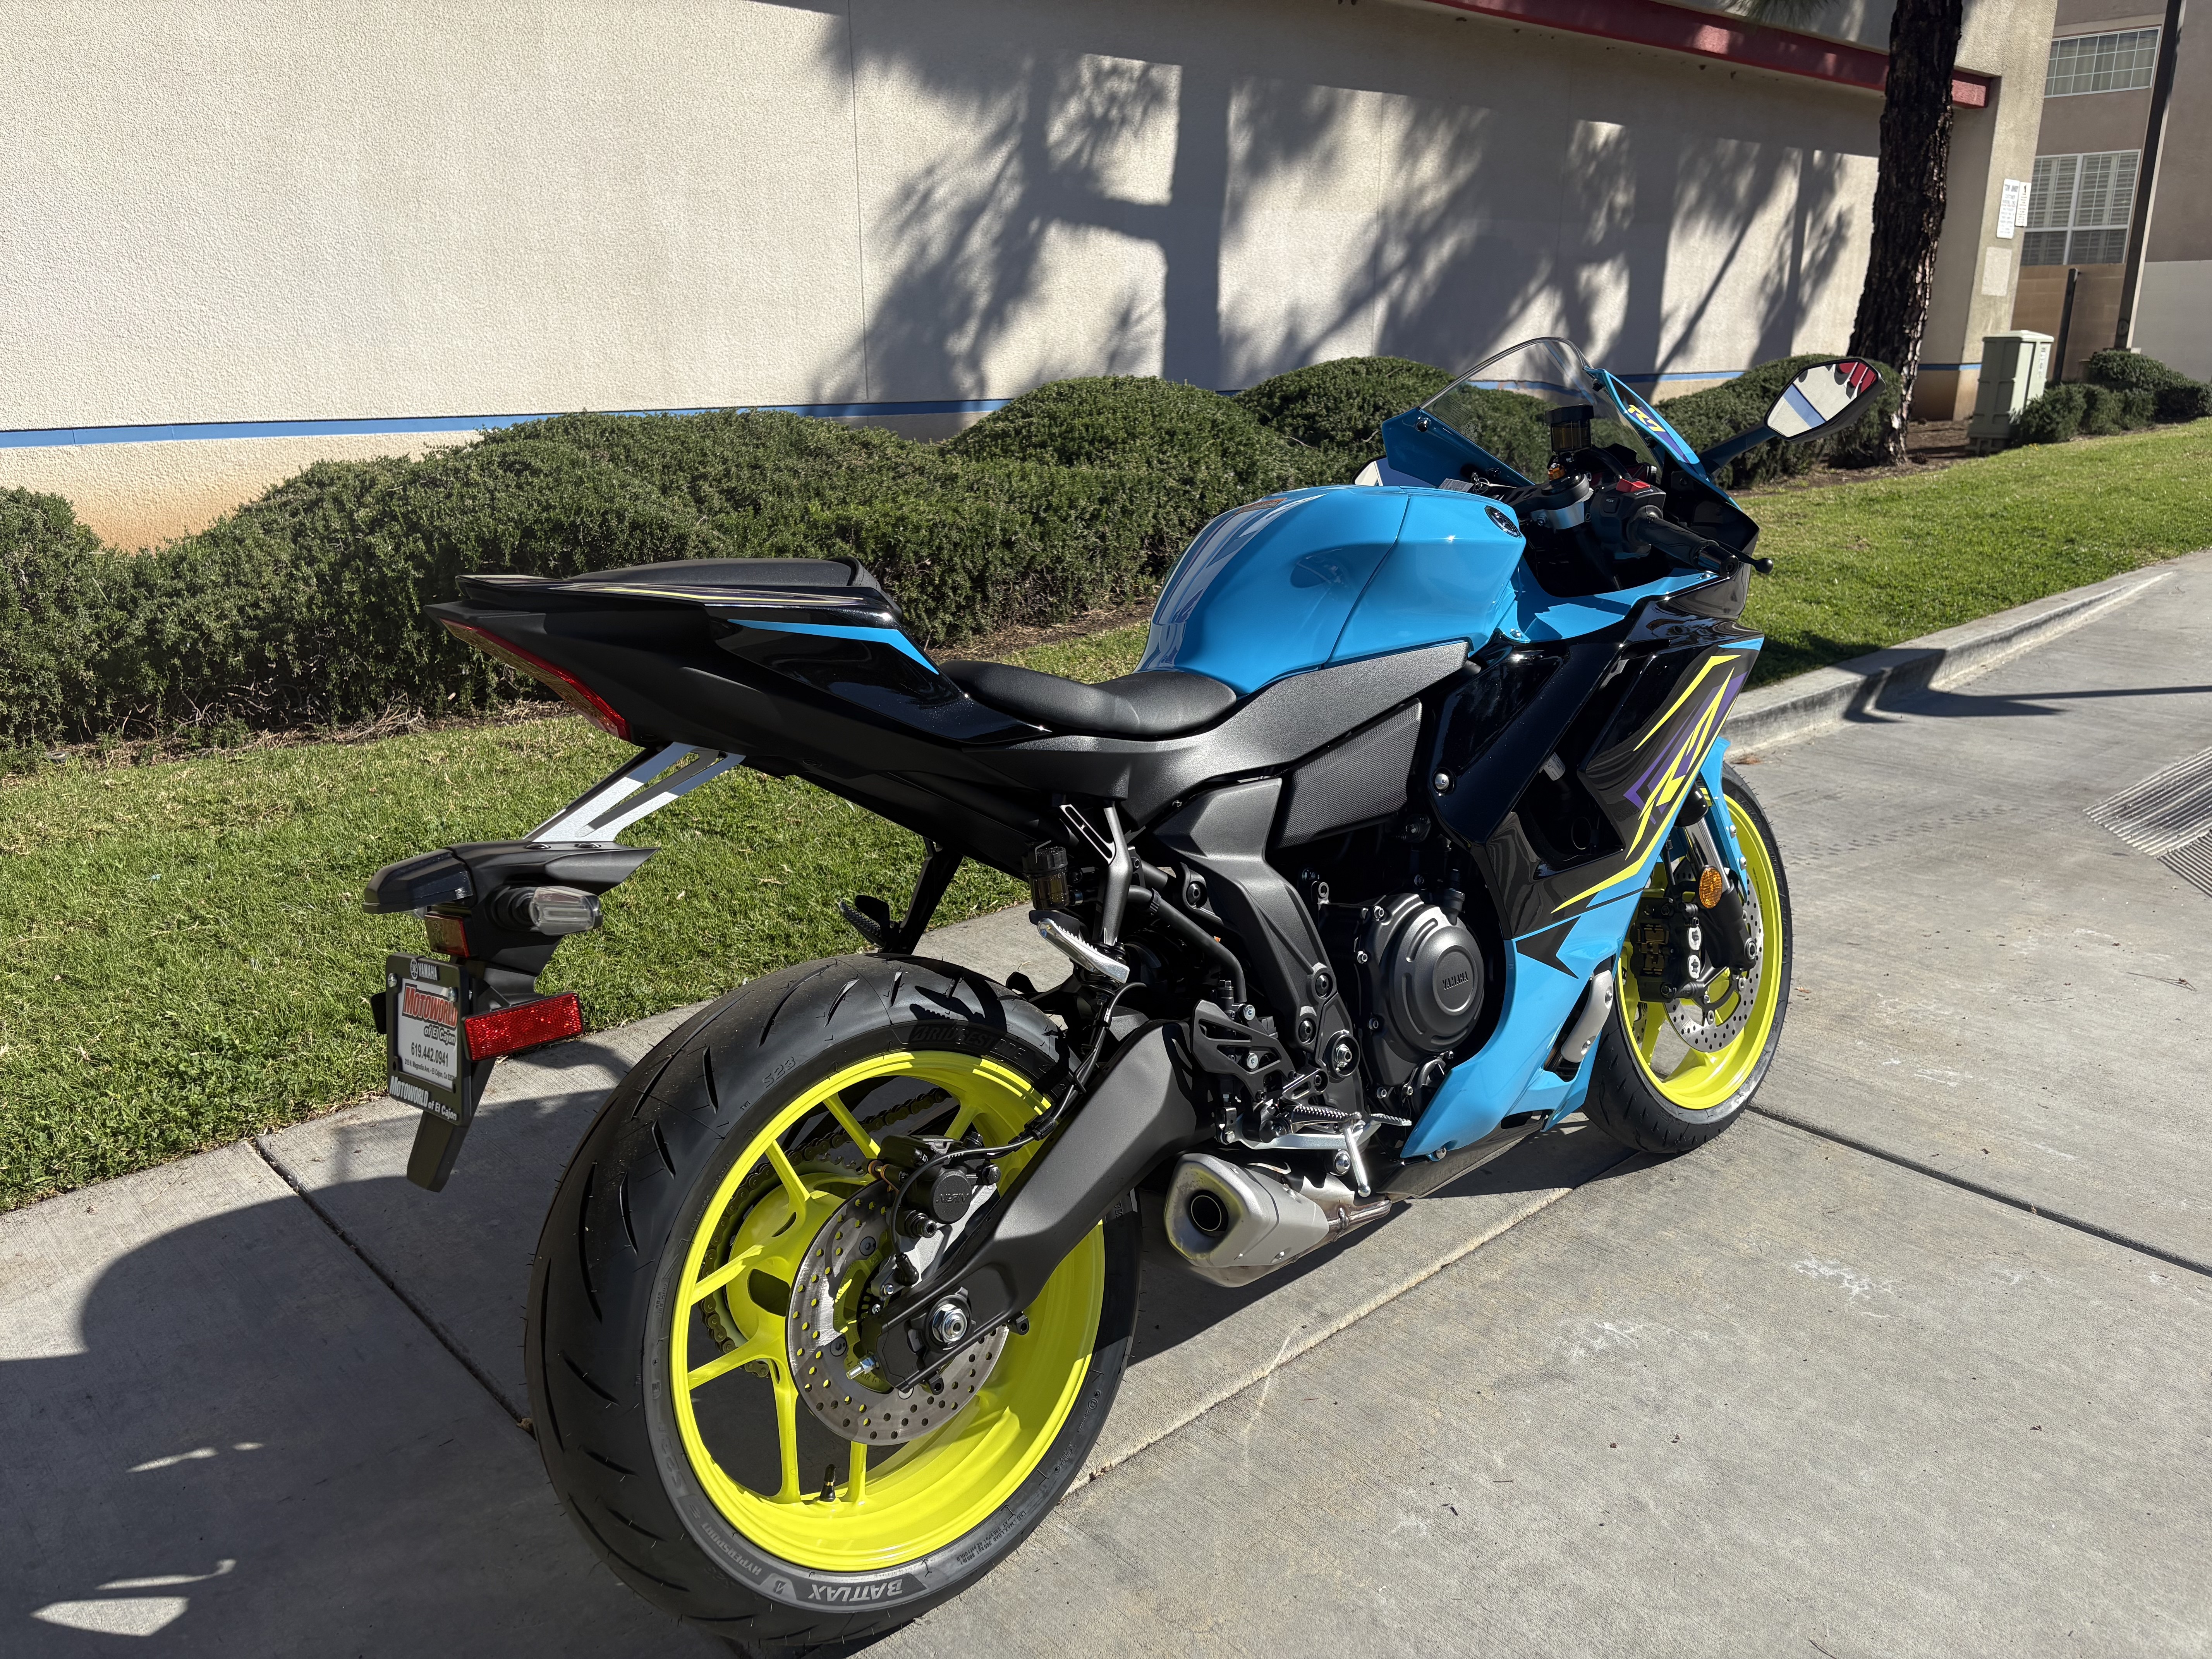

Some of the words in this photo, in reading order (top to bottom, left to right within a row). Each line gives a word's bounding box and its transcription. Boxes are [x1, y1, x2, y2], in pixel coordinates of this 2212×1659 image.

[418, 963, 438, 981] YAMAHA
[1442, 971, 1468, 990] YAMAHA
[404, 986, 458, 1028] MOTOWORLD
[424, 1025, 432, 1036] of
[432, 1027, 439, 1038] El
[440, 1029, 456, 1044] Cajon
[411, 1042, 448, 1067] 619.442.0941
[390, 1076, 429, 1107] MOTOWORLD
[428, 1101, 435, 1110] of
[435, 1102, 441, 1113] El
[441, 1105, 457, 1121] Cajon
[740, 1100, 750, 1111] TWI
[700, 1522, 762, 1576] HYPERSPORT
[808, 1579, 903, 1602] BATTLAX
